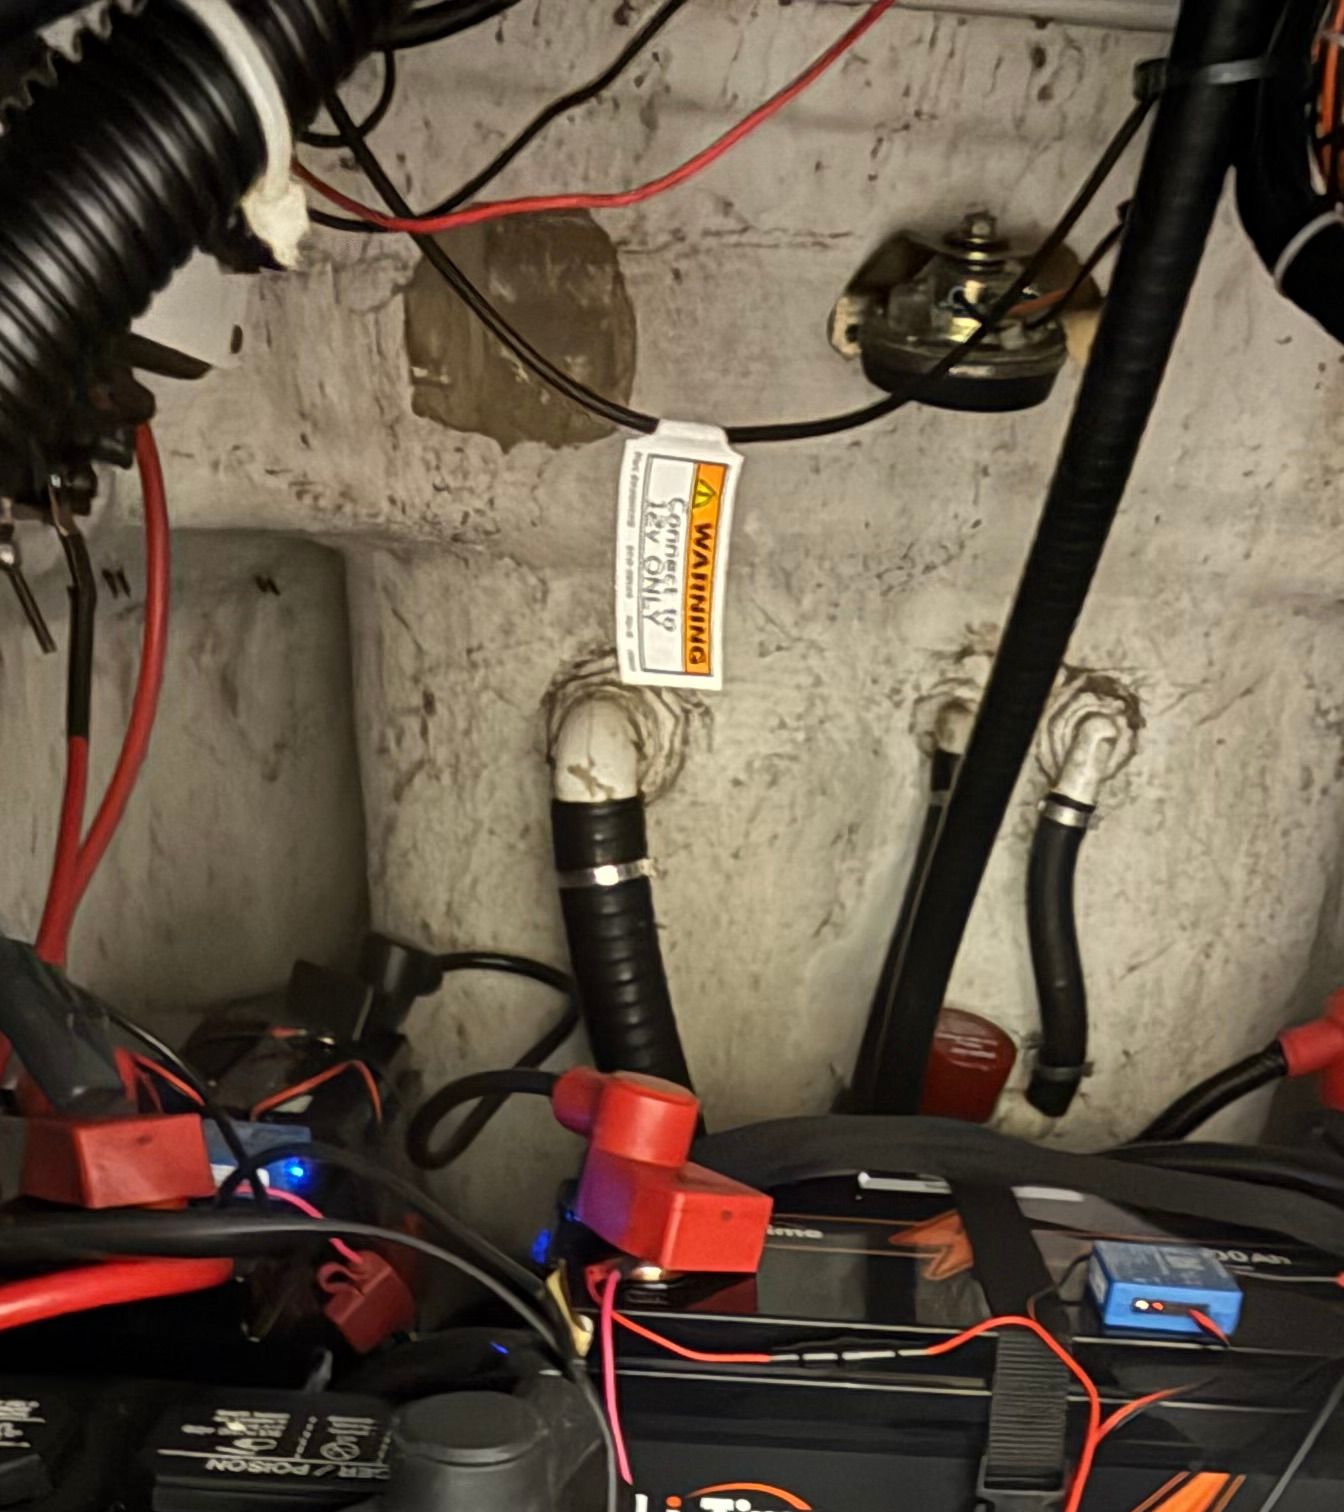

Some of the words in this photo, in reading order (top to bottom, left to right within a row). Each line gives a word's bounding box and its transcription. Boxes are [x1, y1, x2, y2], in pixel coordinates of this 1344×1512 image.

[664, 497, 686, 594] Connect
[641, 555, 664, 626] ONLY
[662, 608, 677, 633] to
[688, 522, 712, 665] WARNING
[205, 1459, 309, 1475] POISON
